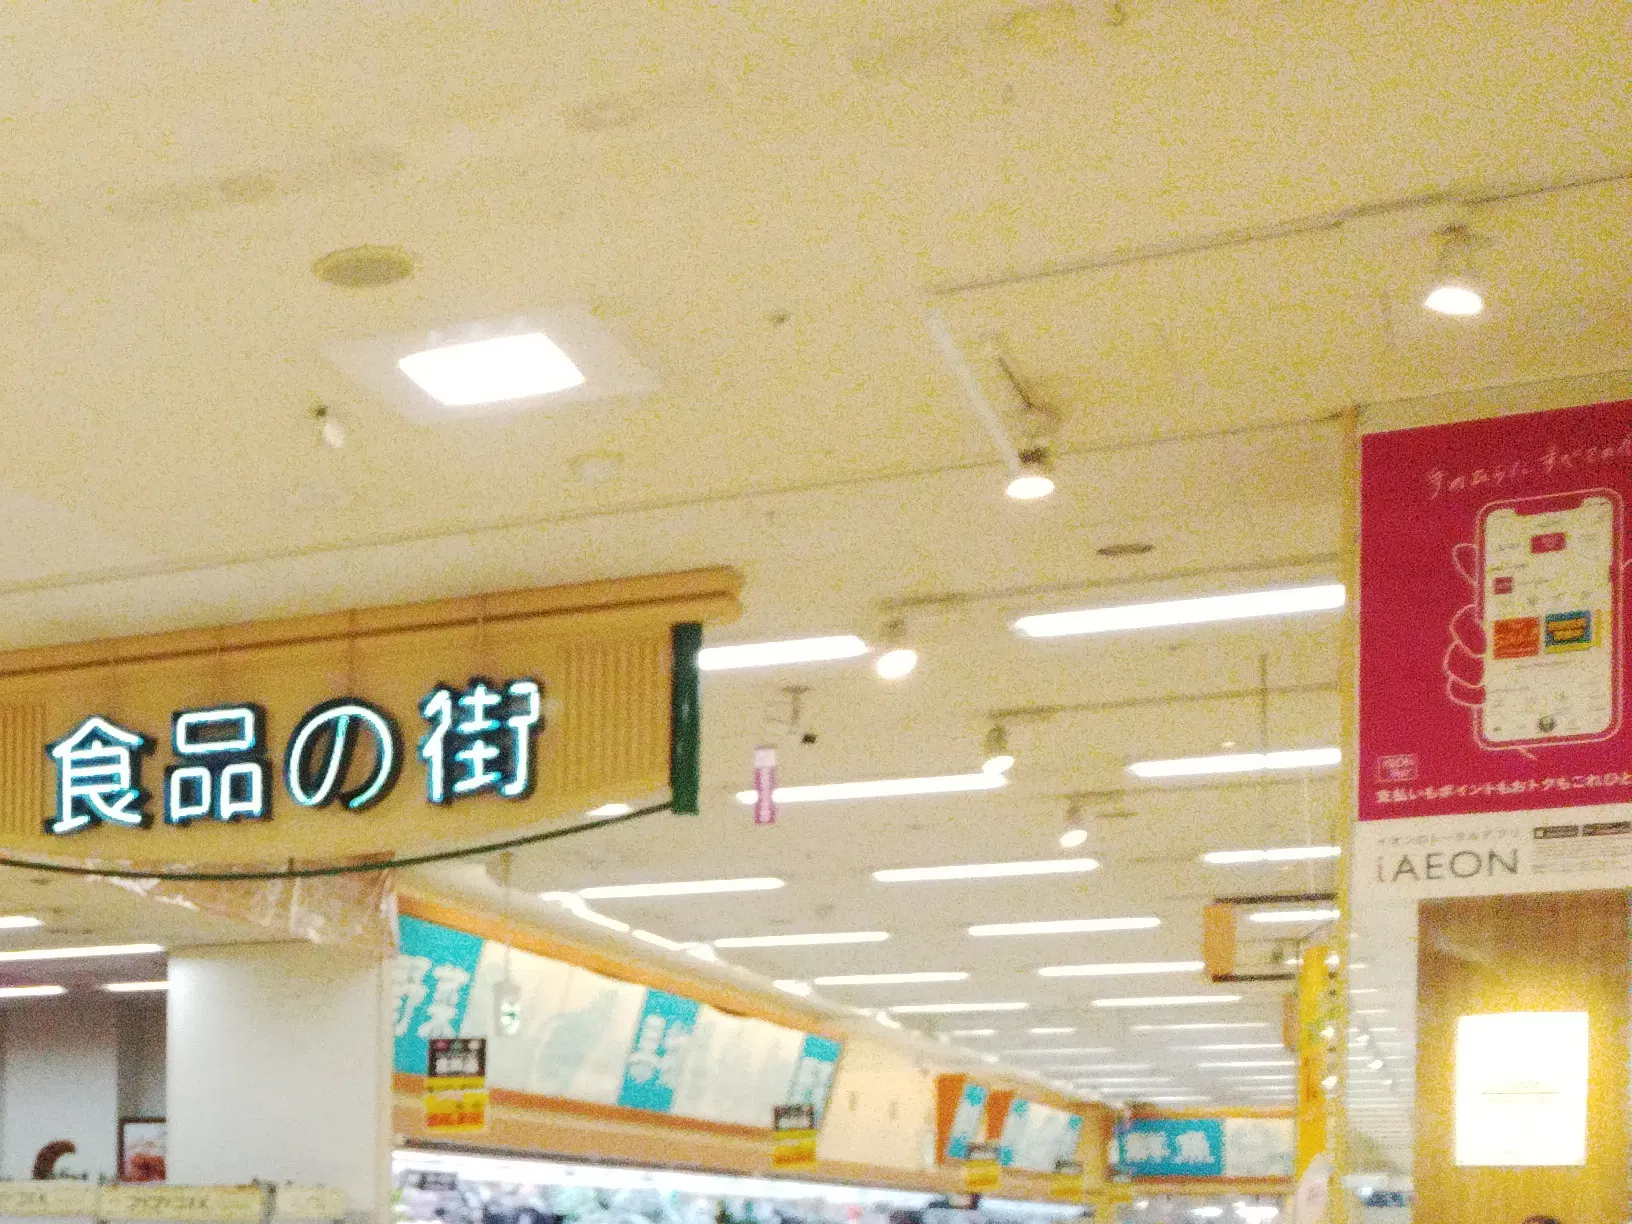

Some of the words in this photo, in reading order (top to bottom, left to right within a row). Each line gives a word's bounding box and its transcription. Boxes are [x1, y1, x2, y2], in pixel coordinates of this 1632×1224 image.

[45, 676, 544, 836] 食品の街
[1377, 849, 1519, 883] iAEON
